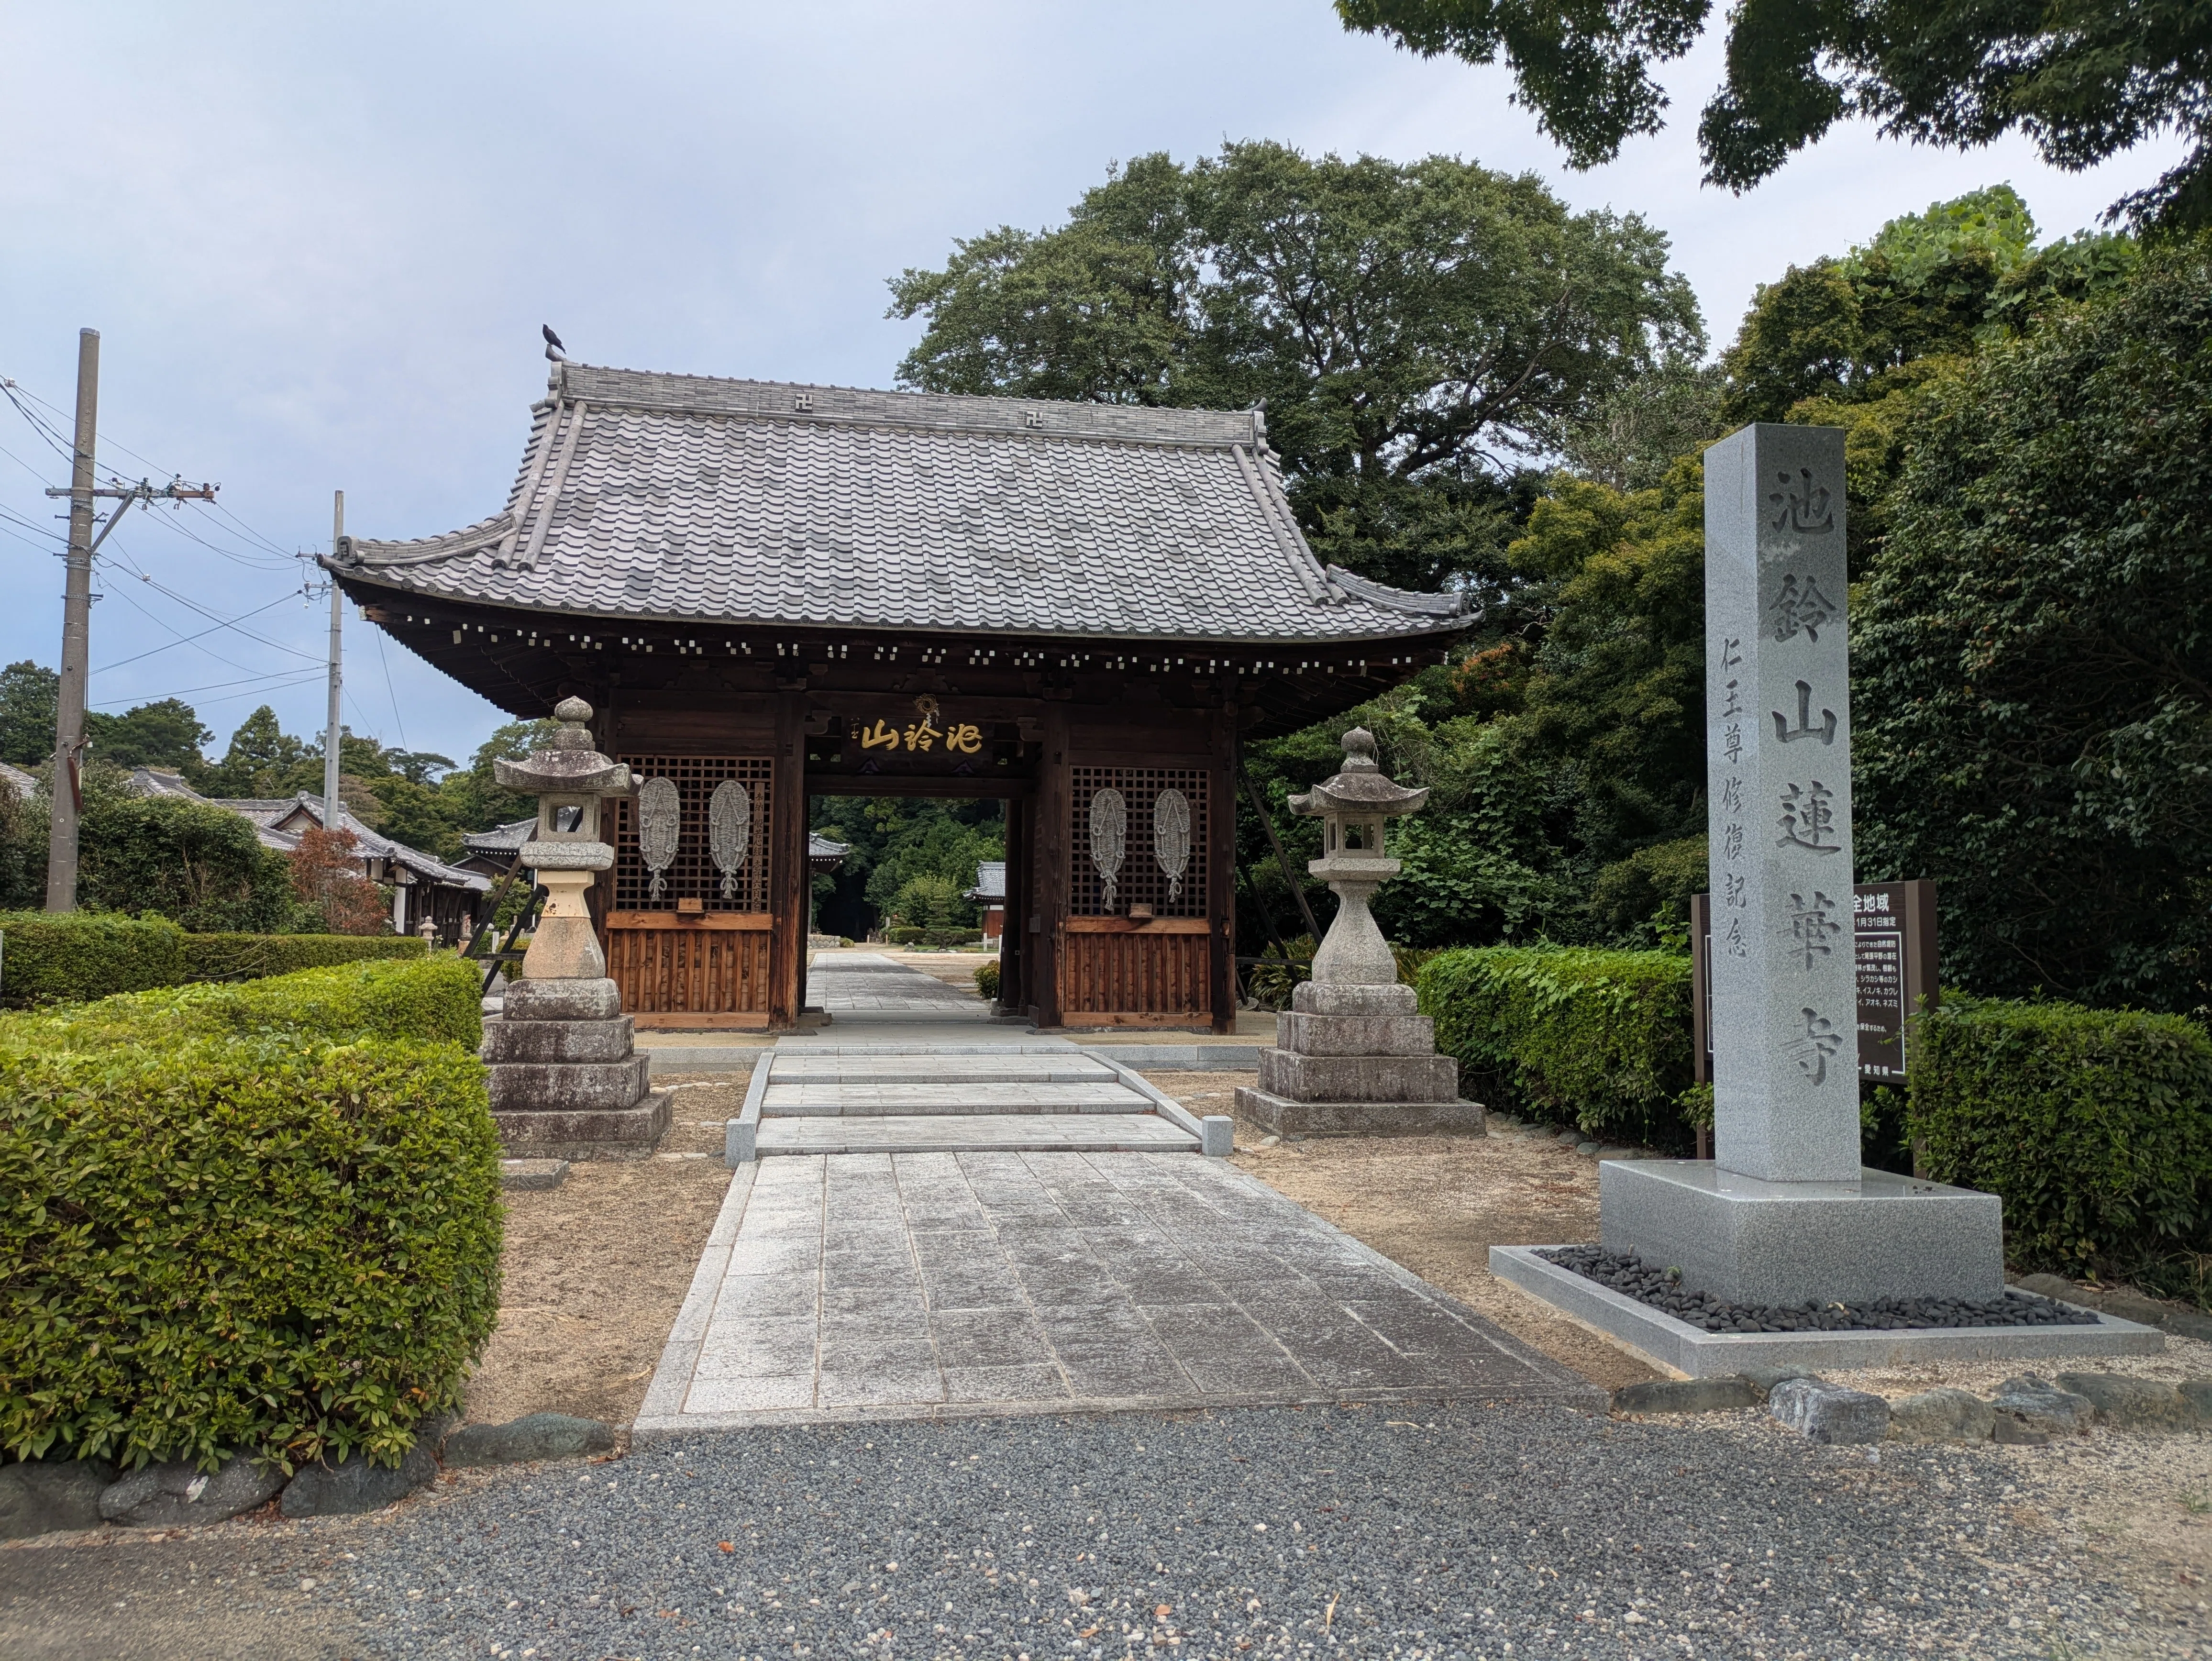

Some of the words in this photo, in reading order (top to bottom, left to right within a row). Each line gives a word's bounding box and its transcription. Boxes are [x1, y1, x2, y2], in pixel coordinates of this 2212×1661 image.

[1769, 467, 1843, 1086] 池鈴山蓮華寺
[1854, 893, 1889, 913] 全地域
[1854, 917, 1896, 927] 1月31日指定
[1856, 974, 1898, 983] 、シラカシ等のカシ
[1856, 998, 1898, 1008] イ、アオキ、ネズミ
[1864, 1064, 1889, 1077] 愛知県
